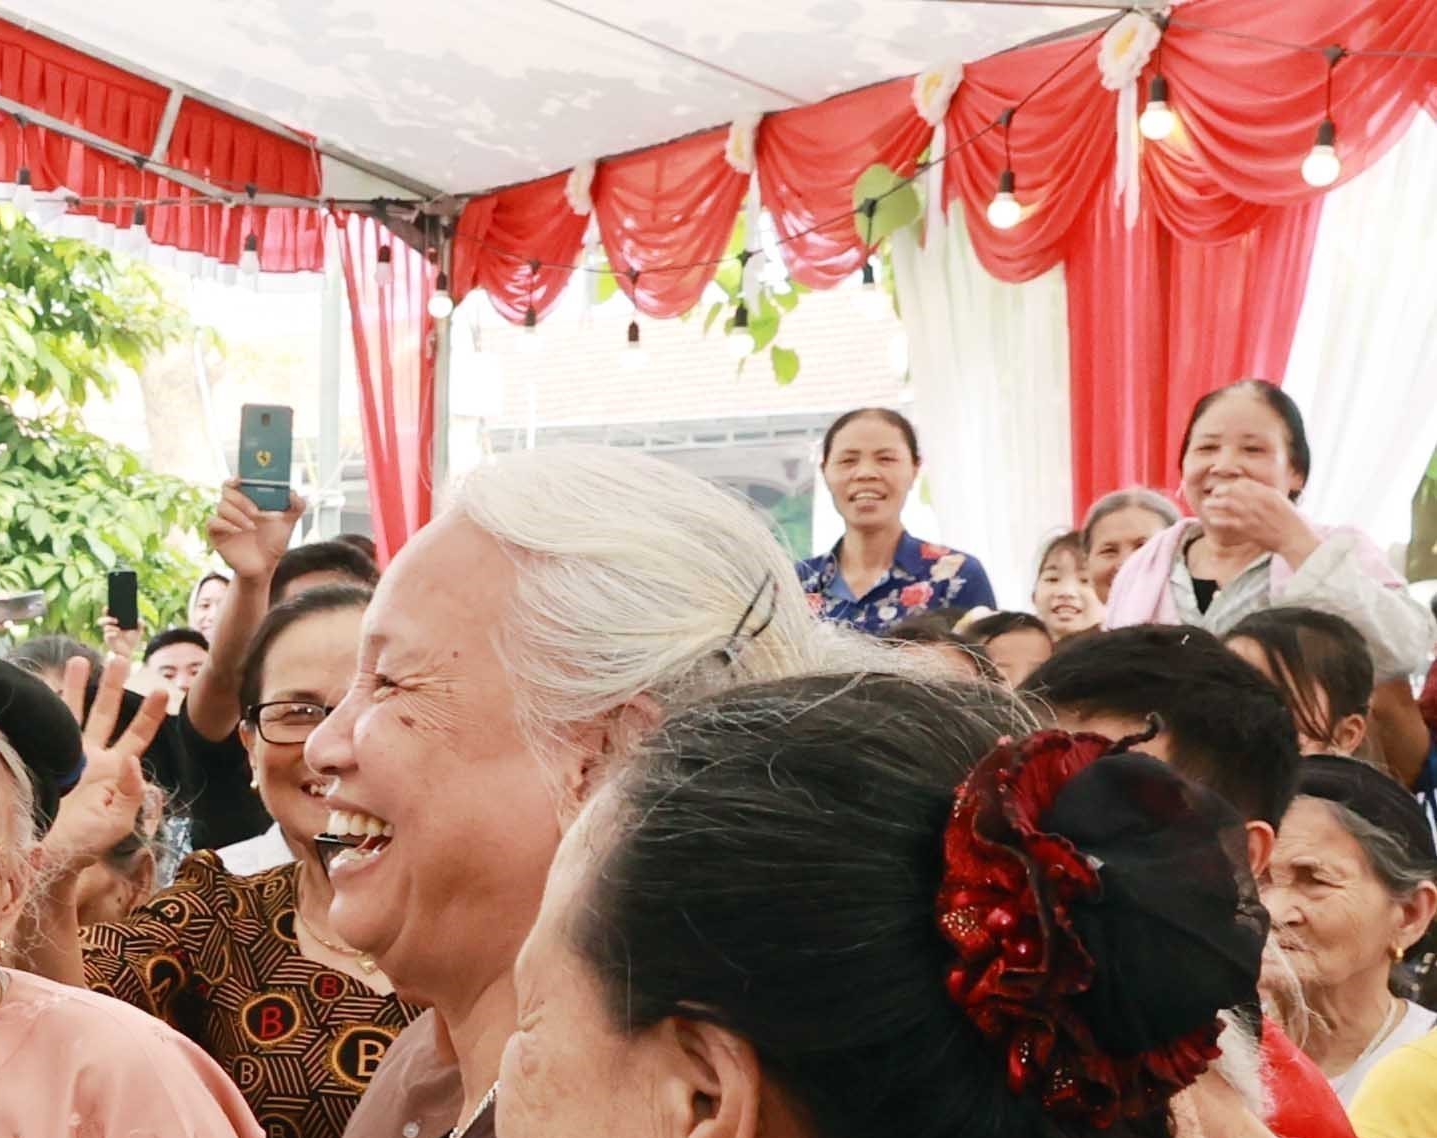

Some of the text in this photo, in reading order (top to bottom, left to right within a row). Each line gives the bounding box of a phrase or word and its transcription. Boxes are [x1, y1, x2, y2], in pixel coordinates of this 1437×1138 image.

[321, 976, 338, 996] B
[260, 1005, 284, 1038] B
[356, 1039, 386, 1077] B
[240, 1061, 254, 1085] B
